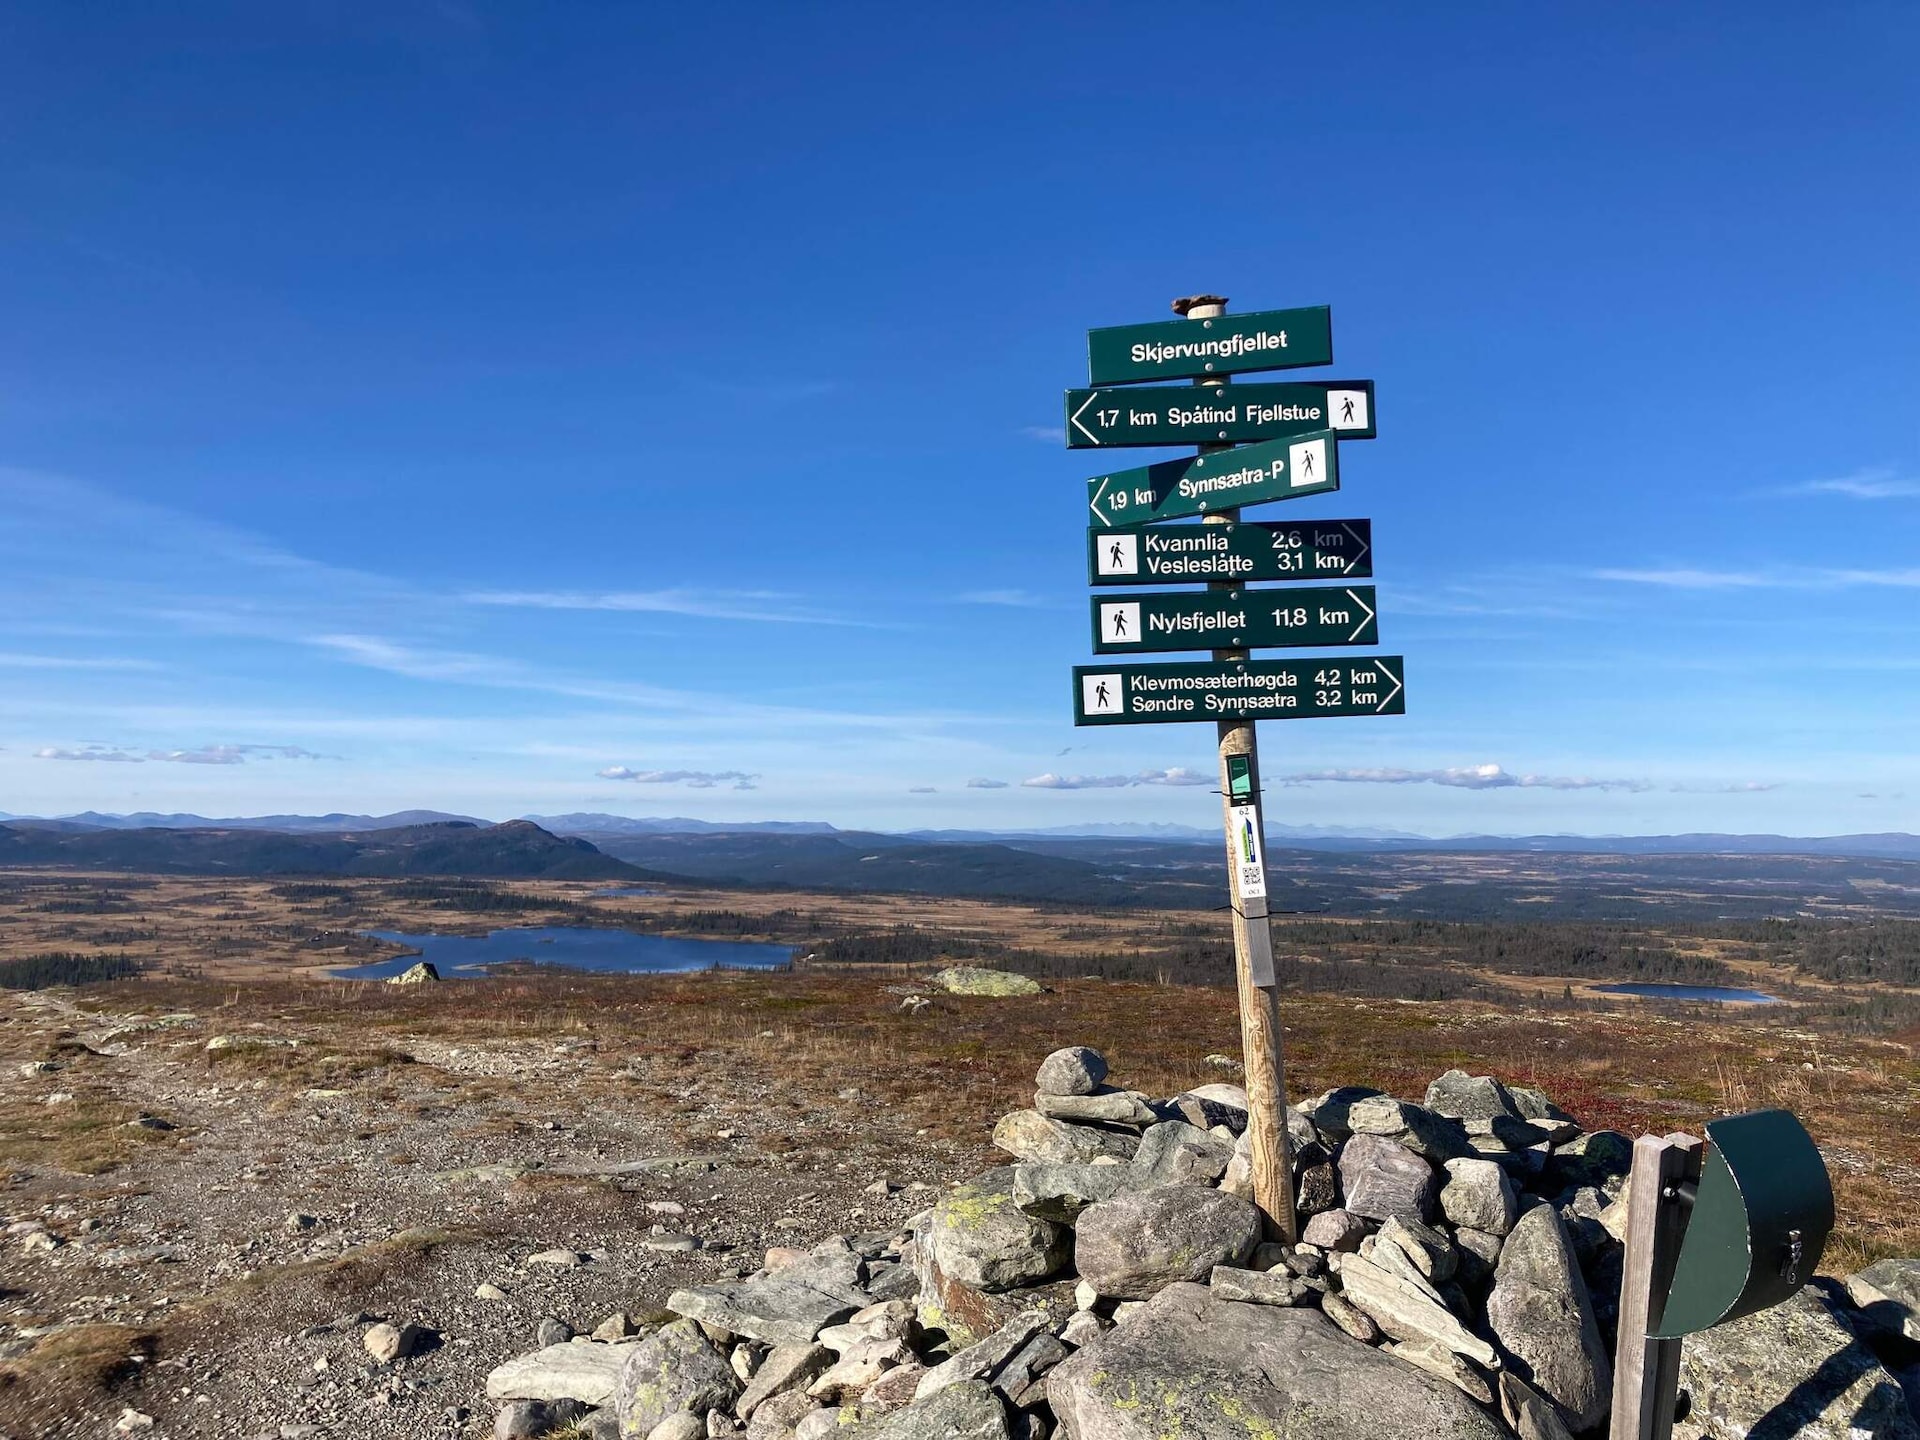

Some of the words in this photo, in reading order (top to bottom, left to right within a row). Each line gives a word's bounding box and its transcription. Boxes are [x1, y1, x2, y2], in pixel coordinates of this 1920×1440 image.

[1131, 330, 1288, 364] Skjervungfjellet
[1096, 408, 1120, 428] 1,7
[1129, 408, 1158, 426] km
[1167, 405, 1237, 427] Spåtind
[1246, 404, 1321, 427] Fjellstue
[1107, 490, 1127, 511] 1,9
[1135, 487, 1157, 504] km
[1178, 460, 1285, 500] Synnsætra-P
[1145, 534, 1229, 552] Kvannlia
[1271, 531, 1302, 551] 2,6
[1314, 530, 1343, 547] km
[1146, 552, 1254, 574] Vesleslåtte
[1277, 553, 1304, 571] 3,1
[1315, 552, 1345, 569] km
[1149, 611, 1247, 632] Nylsfjellet
[1271, 608, 1307, 627] 11,8
[1319, 606, 1350, 625] km
[1130, 671, 1298, 692] Klevmosæterhøgda
[1314, 669, 1341, 686] 4,2
[1350, 668, 1377, 684] km
[1132, 695, 1194, 712] Søndre
[1205, 694, 1297, 712] Synnsætra
[1315, 690, 1342, 707] 3,2
[1351, 689, 1378, 704] km
[1239, 807, 1250, 816] 62
